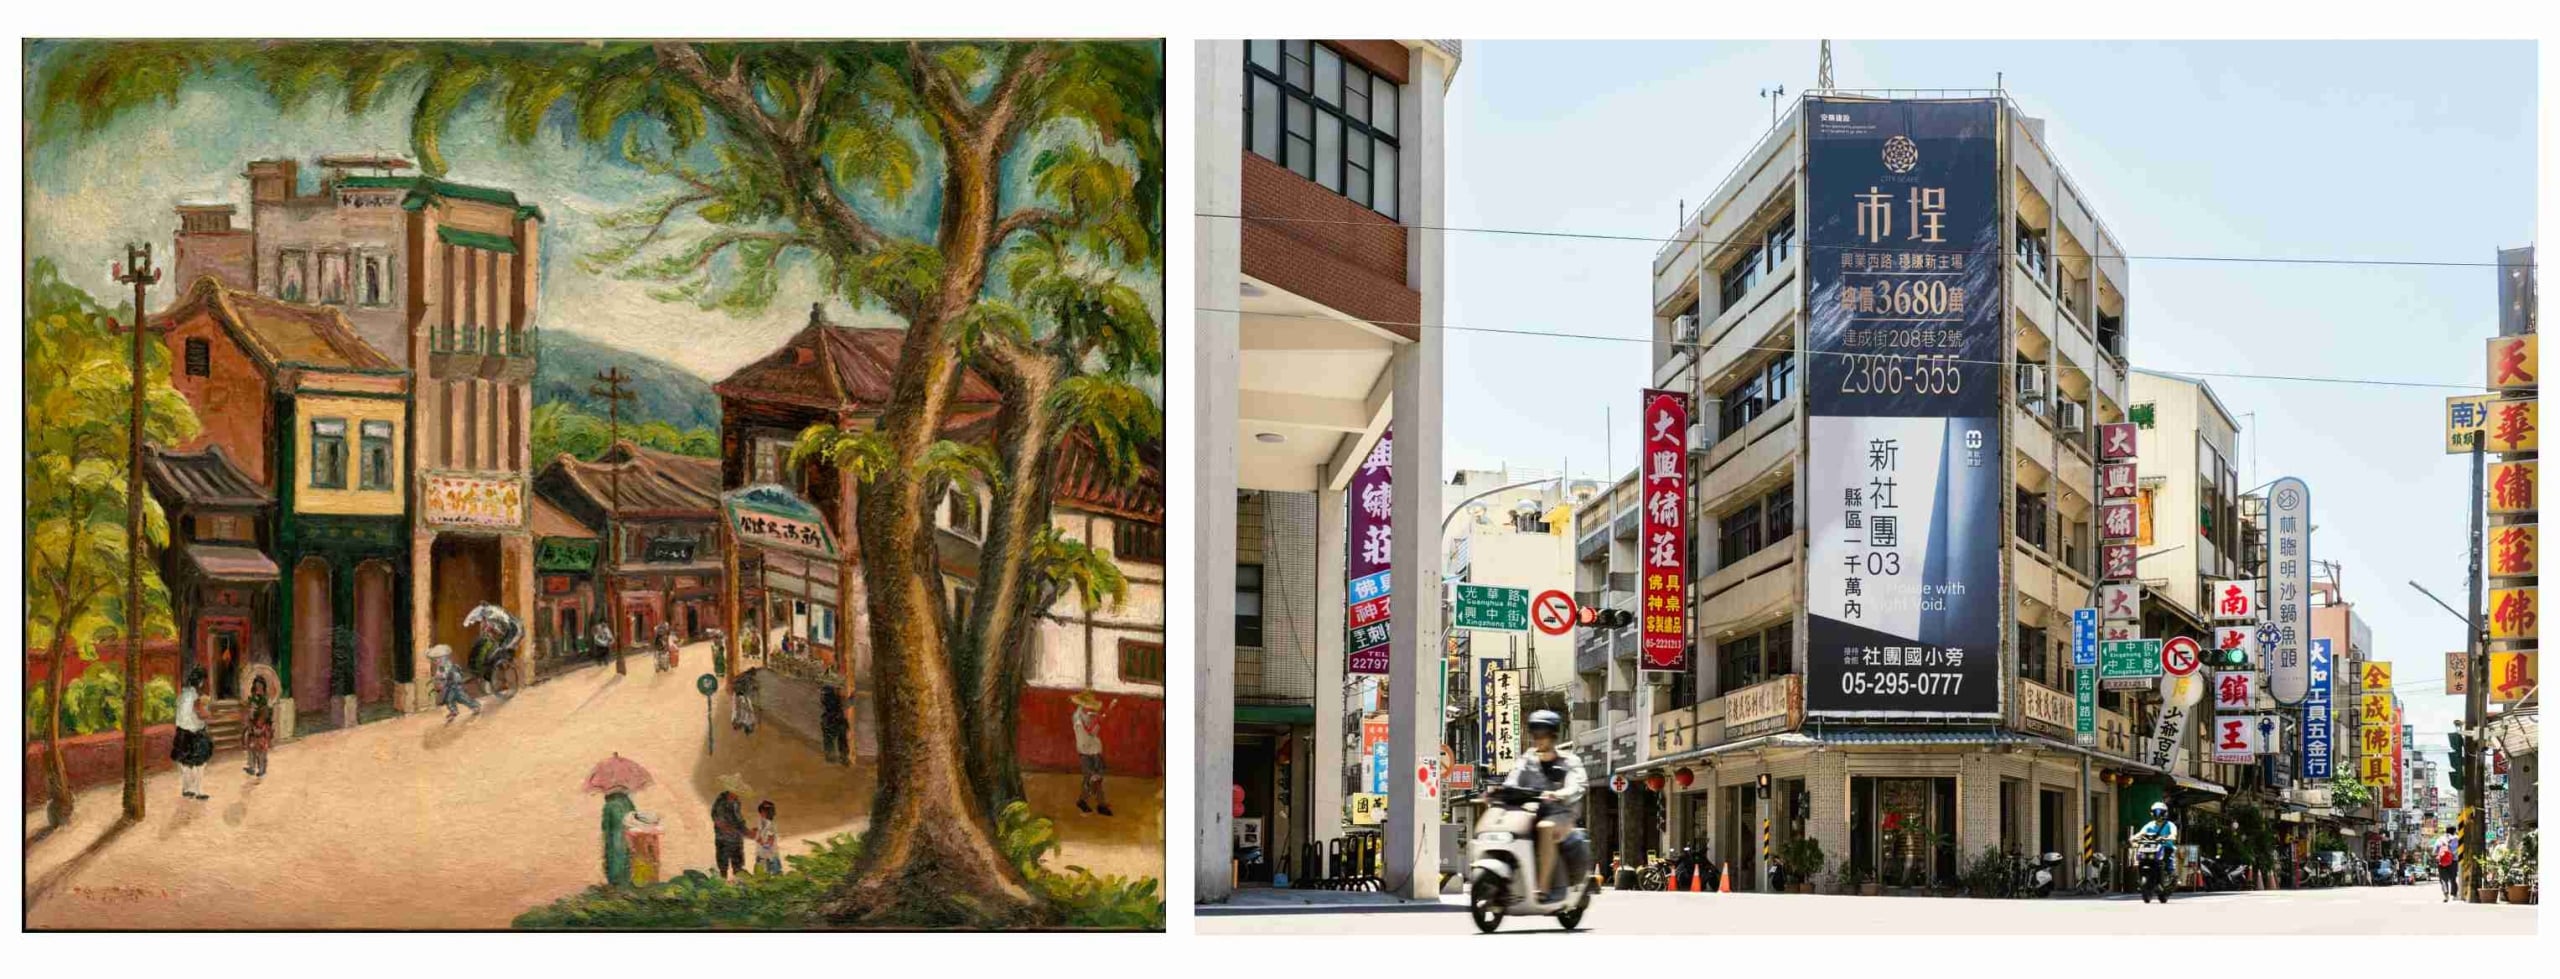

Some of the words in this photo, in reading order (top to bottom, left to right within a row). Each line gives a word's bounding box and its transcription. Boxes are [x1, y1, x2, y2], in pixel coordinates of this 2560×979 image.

[1854, 186, 1947, 243] 市埕
[1841, 354, 1960, 394] 2366-555
[1844, 488, 1862, 619] 縣區一千萬內
[1465, 586, 1520, 602] 光華路
[1648, 574, 1681, 592] 佛具
[1936, 581, 1966, 595] with
[2279, 516, 2298, 668] 林聰明沙鍋魚頭
[1465, 606, 1520, 622] 興中街
[1862, 646, 1964, 666] 社團國小旁
[2108, 658, 2153, 669] 中正路
[1842, 672, 1963, 695] 05-295-0777
[2080, 680, 2091, 717] 光華路
[2307, 641, 2328, 775] 大和工具五金行
